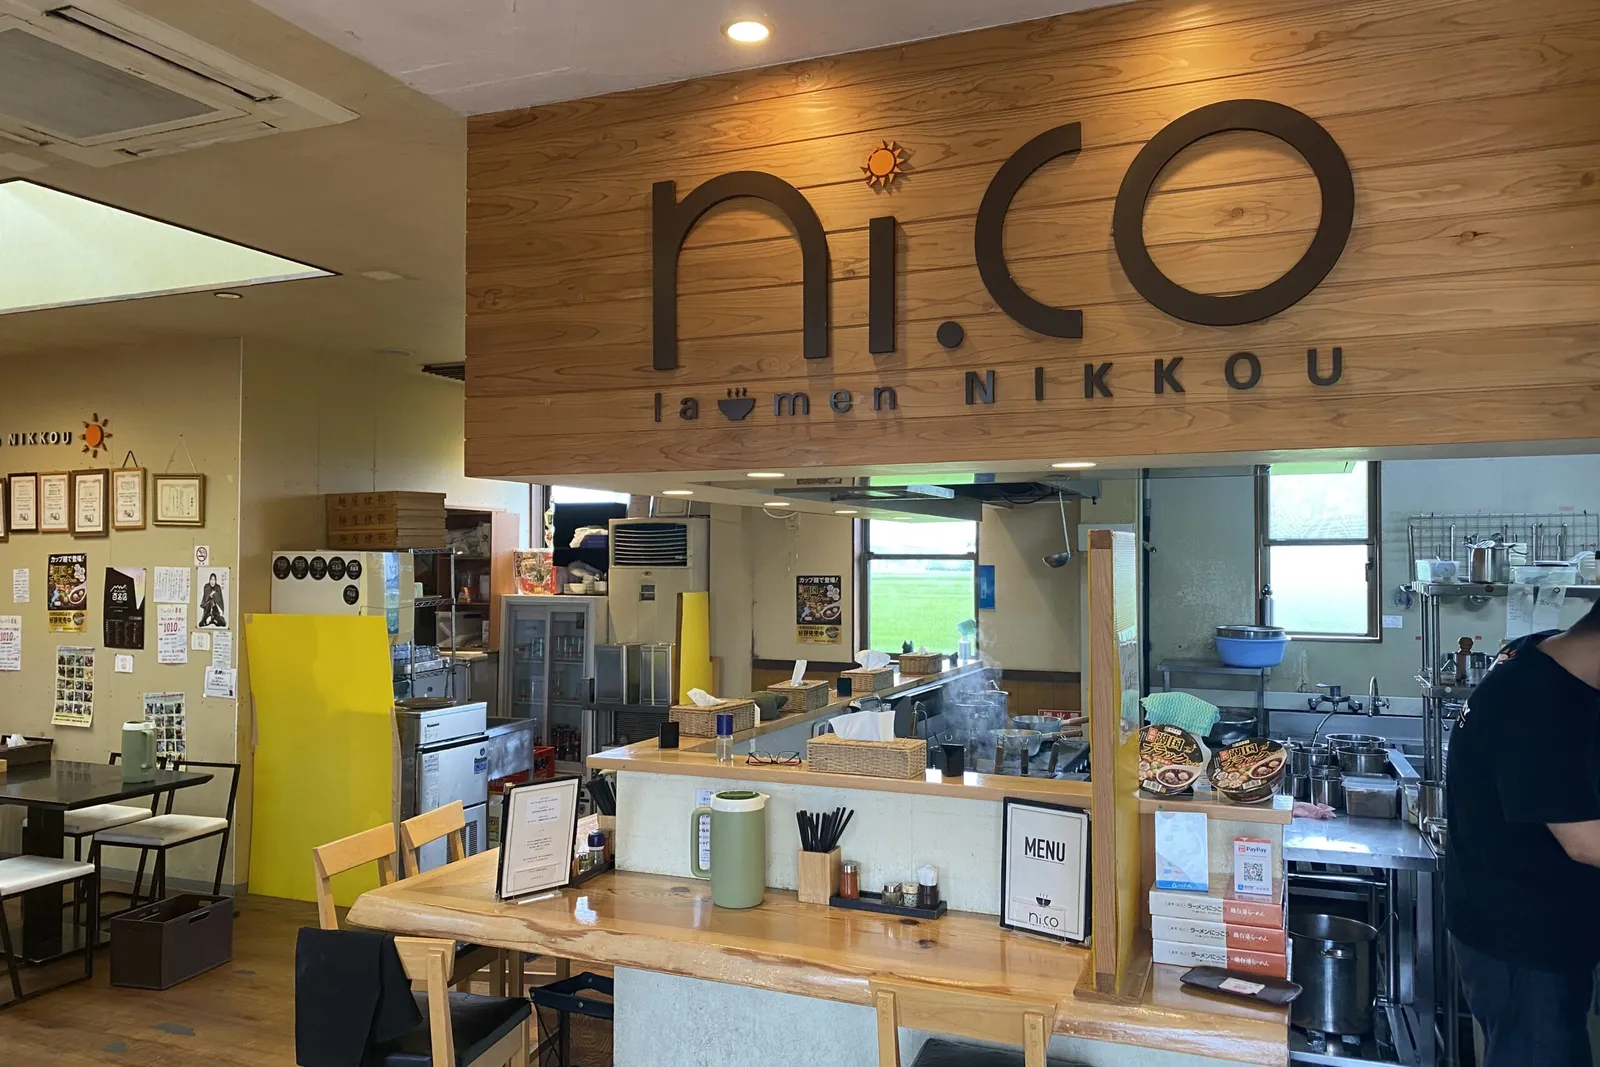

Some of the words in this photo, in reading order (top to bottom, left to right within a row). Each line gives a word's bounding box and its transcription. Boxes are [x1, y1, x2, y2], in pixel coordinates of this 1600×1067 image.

[965, 346, 1344, 405] NIKKOU
[8, 431, 72, 446] NIKKOU
[1155, 732, 1185, 751] 湖国
[1141, 742, 1189, 764] ブラック
[1024, 836, 1066, 862] MENU
